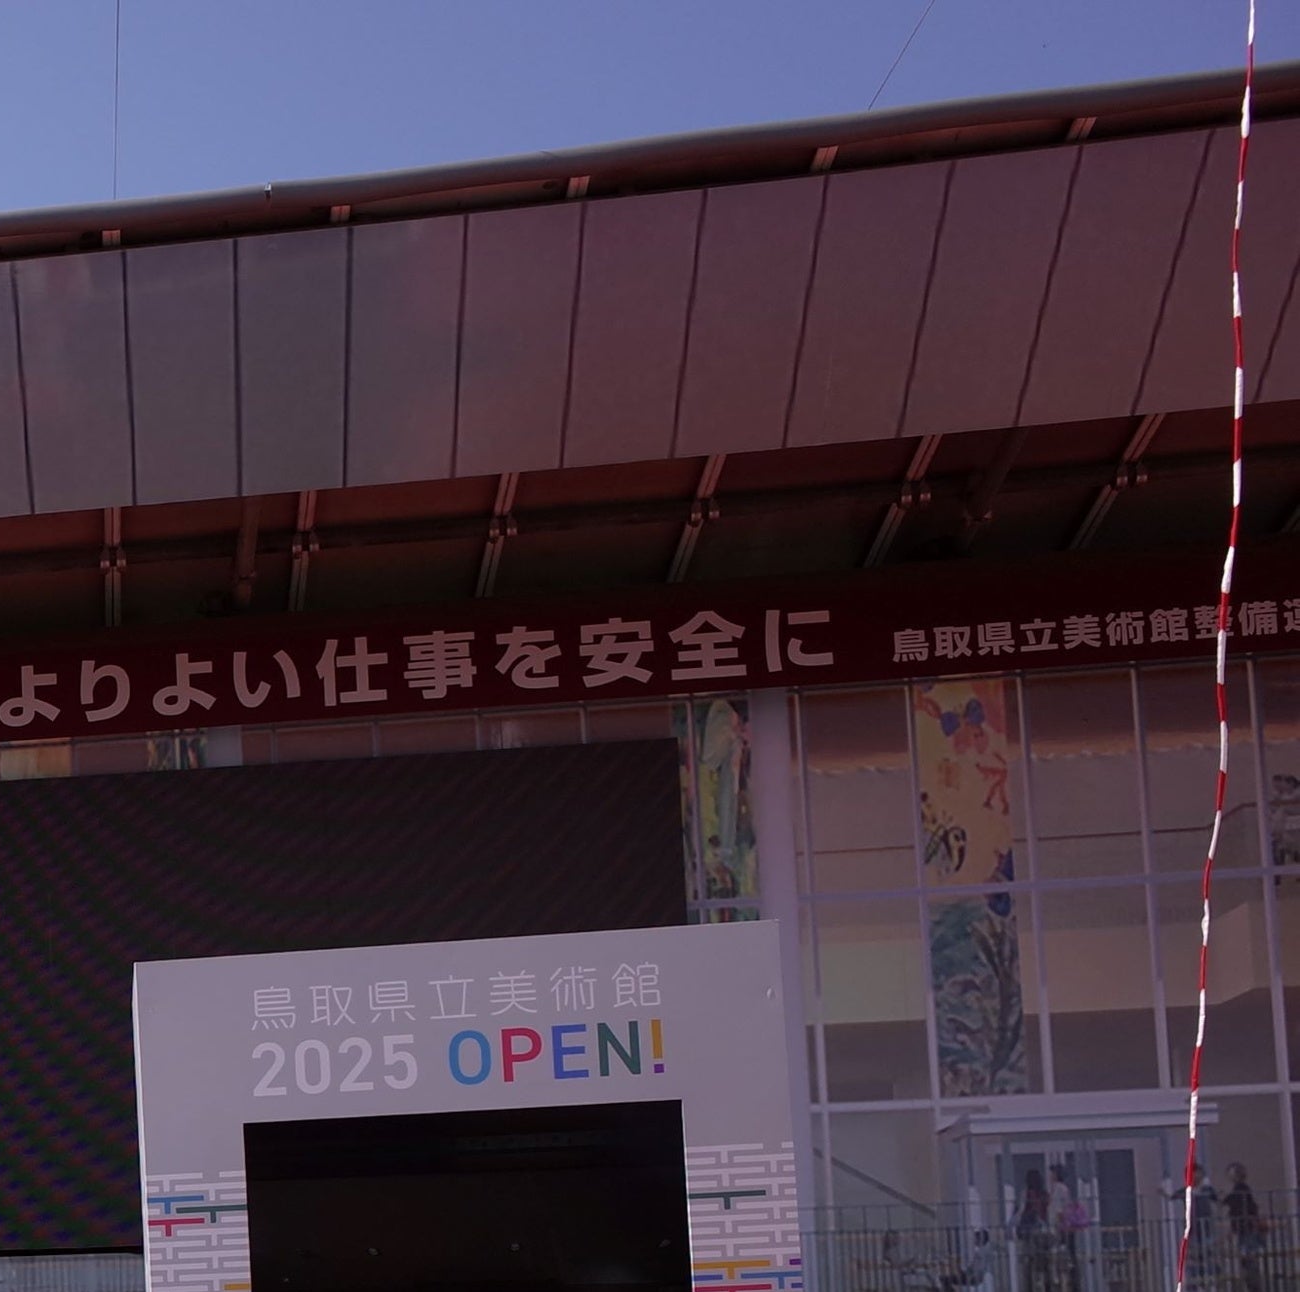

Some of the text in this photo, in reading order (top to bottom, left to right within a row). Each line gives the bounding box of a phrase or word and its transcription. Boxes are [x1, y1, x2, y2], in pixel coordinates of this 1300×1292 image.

[251, 961, 663, 1031] 鳥取県立美術館
[251, 1018, 666, 1098] 2025 OPEN!
